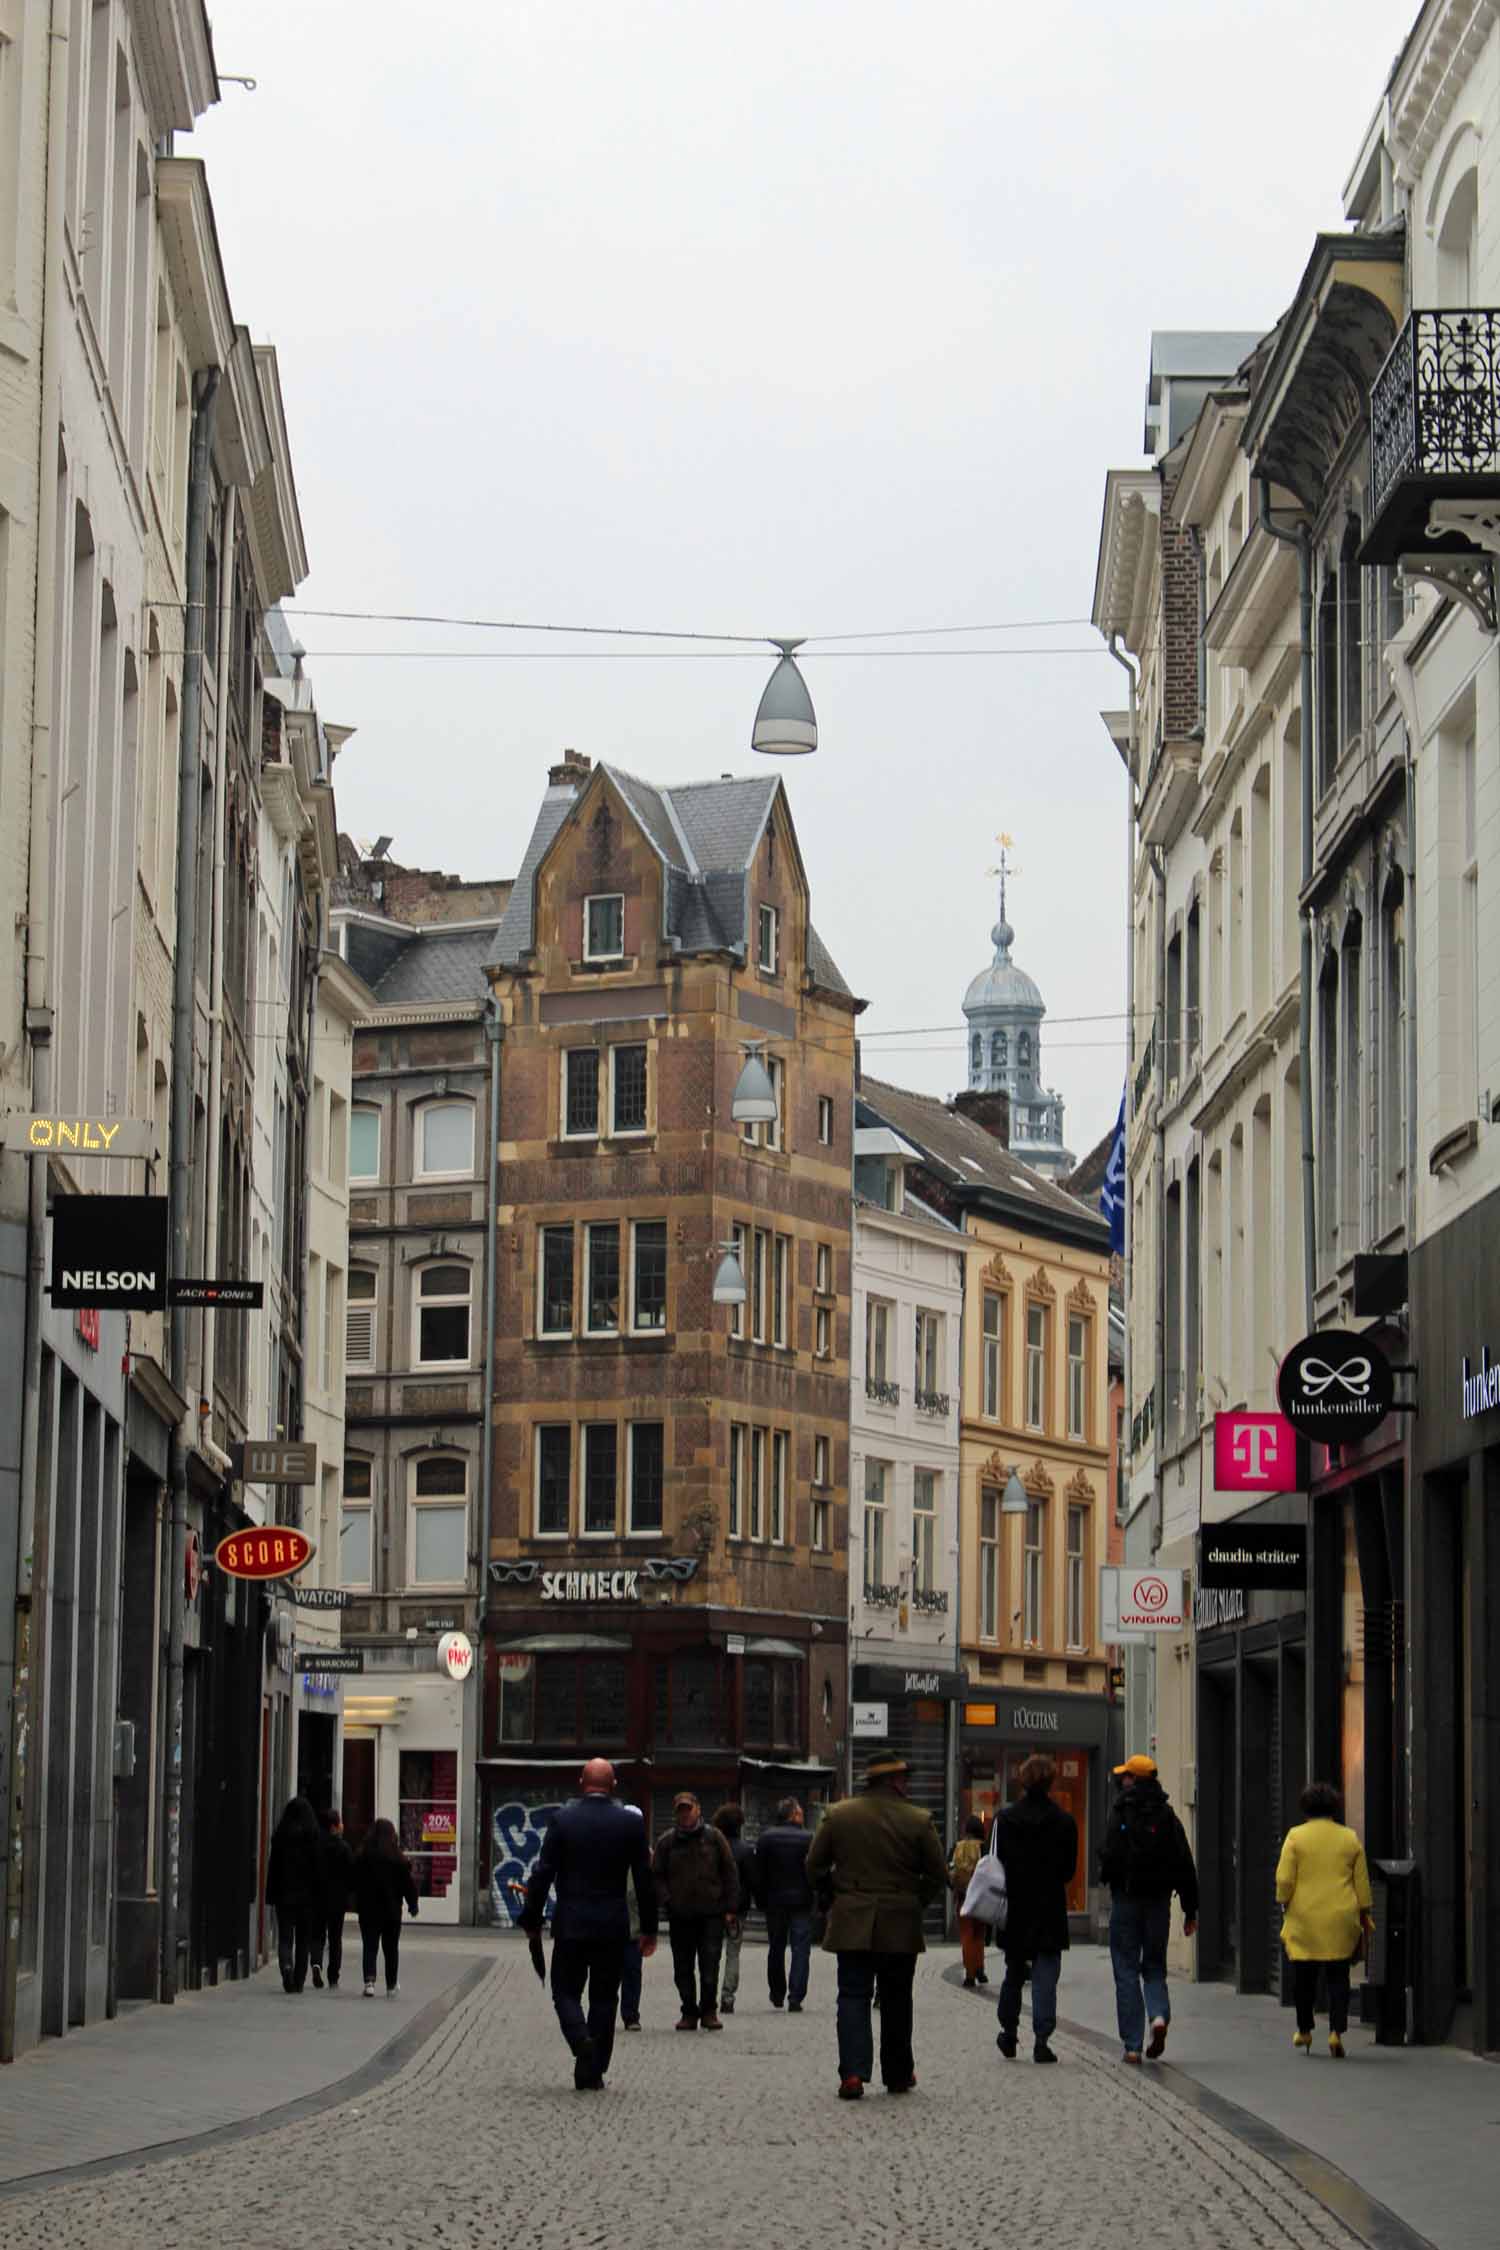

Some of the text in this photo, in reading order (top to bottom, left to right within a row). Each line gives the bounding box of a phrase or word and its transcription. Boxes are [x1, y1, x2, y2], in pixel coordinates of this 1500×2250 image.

[29, 1119, 120, 1150] ONLY
[61, 1270, 157, 1291] NELSON
[176, 1288, 207, 1298] JACK
[217, 1289, 254, 1300] JONES
[1290, 1400, 1383, 1416] hunkemöller
[1233, 1424, 1277, 1479] T
[252, 1451, 305, 1475] WE
[227, 1538, 300, 1568] SCORE
[1208, 1547, 1300, 1565] claudia sträter
[294, 1590, 347, 1607] WATCH!
[1013, 1706, 1060, 1731] L'OCCITANE
